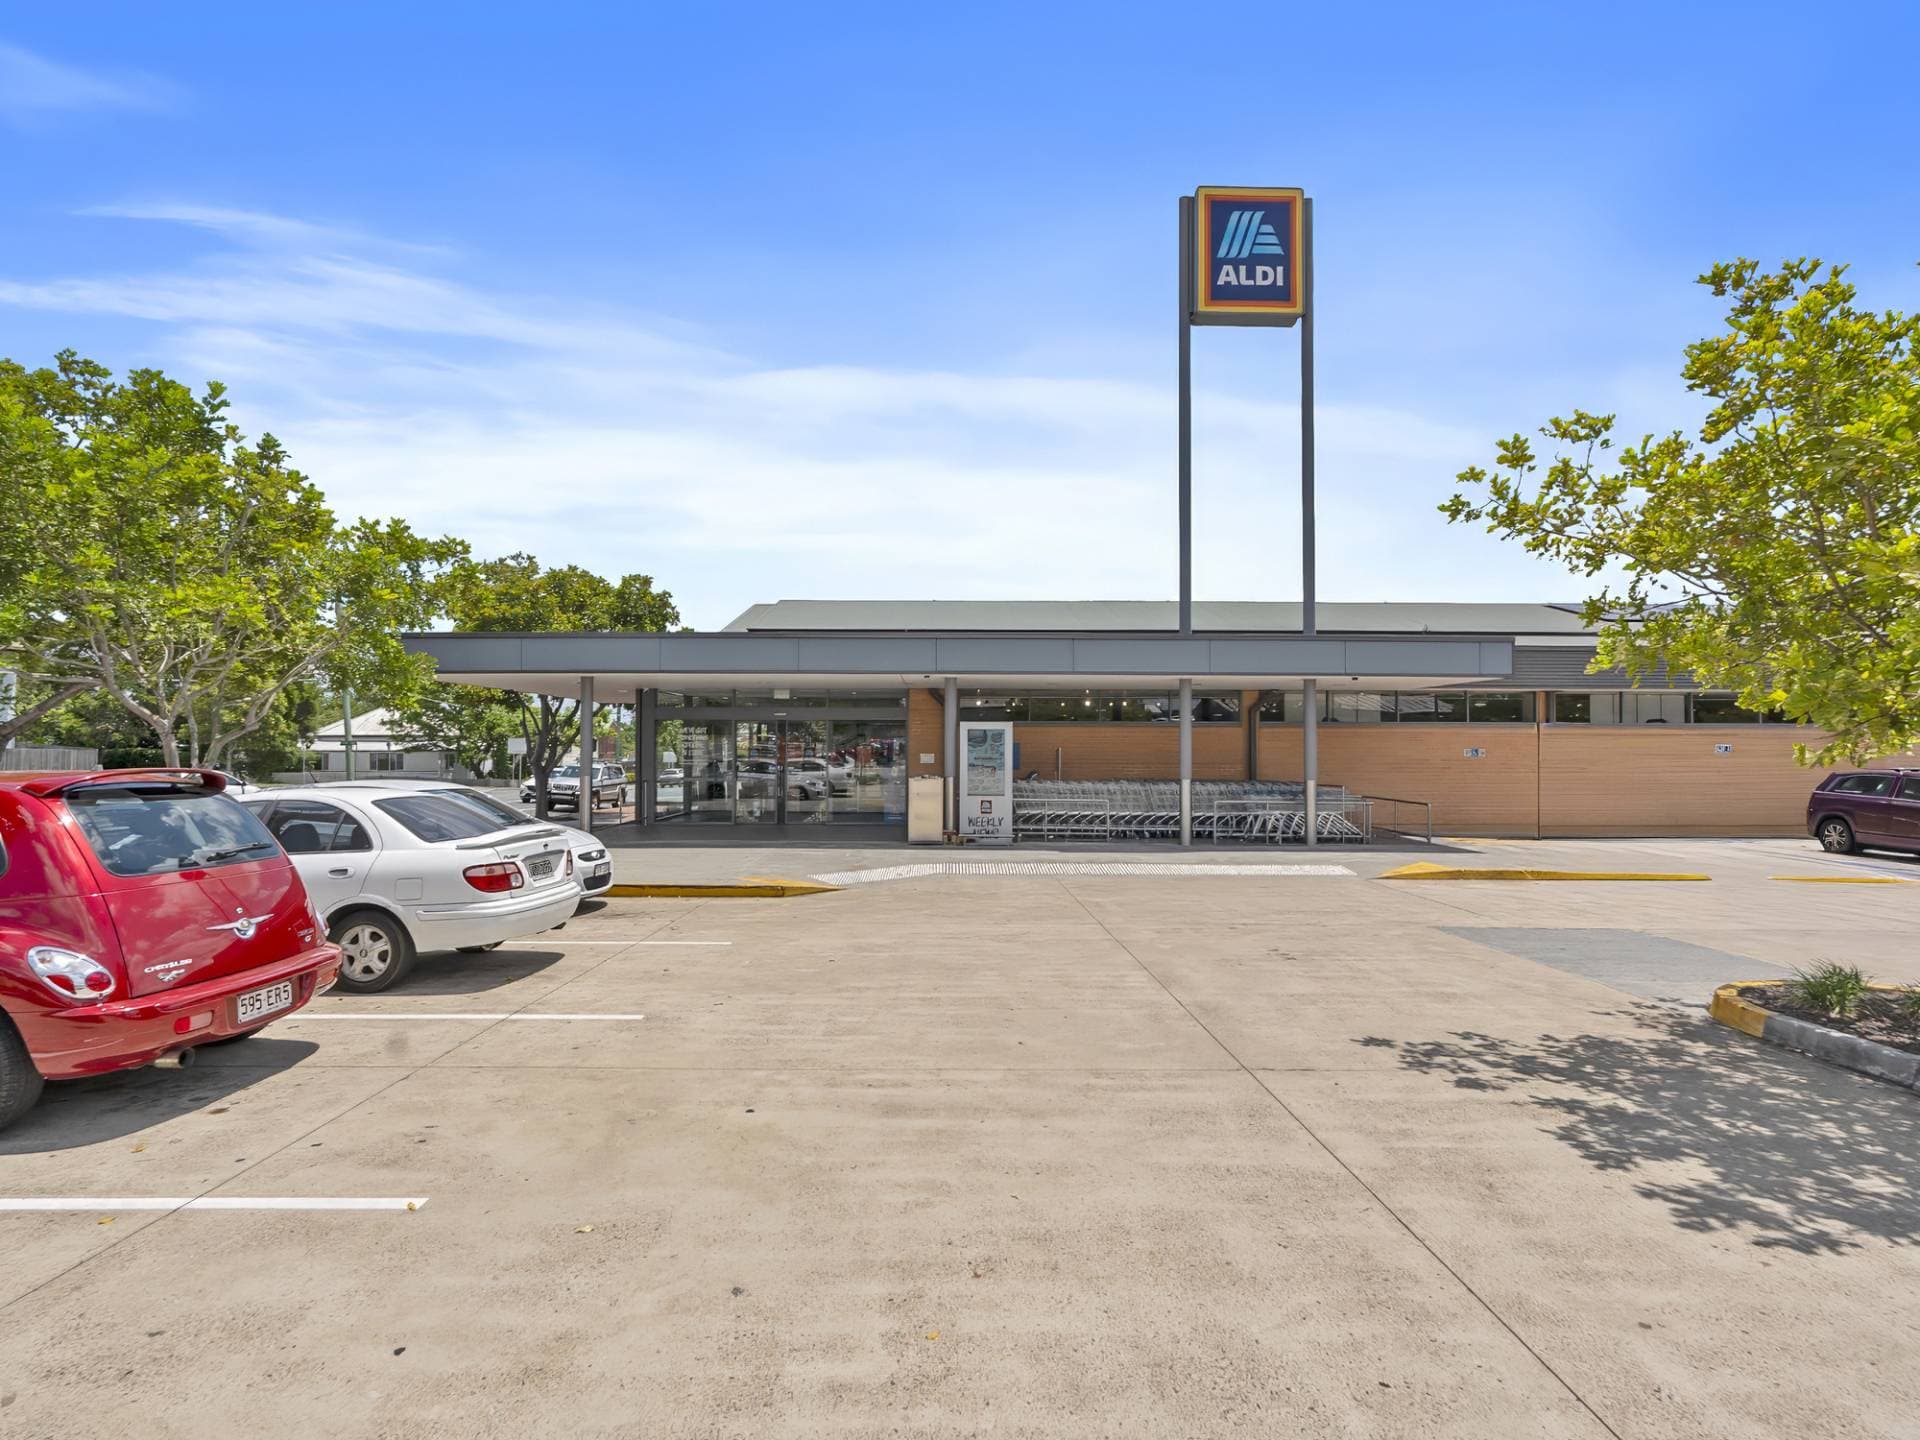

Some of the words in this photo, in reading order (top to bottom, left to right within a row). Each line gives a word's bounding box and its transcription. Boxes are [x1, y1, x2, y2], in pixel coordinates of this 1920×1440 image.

[1217, 265, 1284, 286] ALDI
[967, 815, 1005, 828] WEEKLY
[240, 993, 262, 1016] 595
